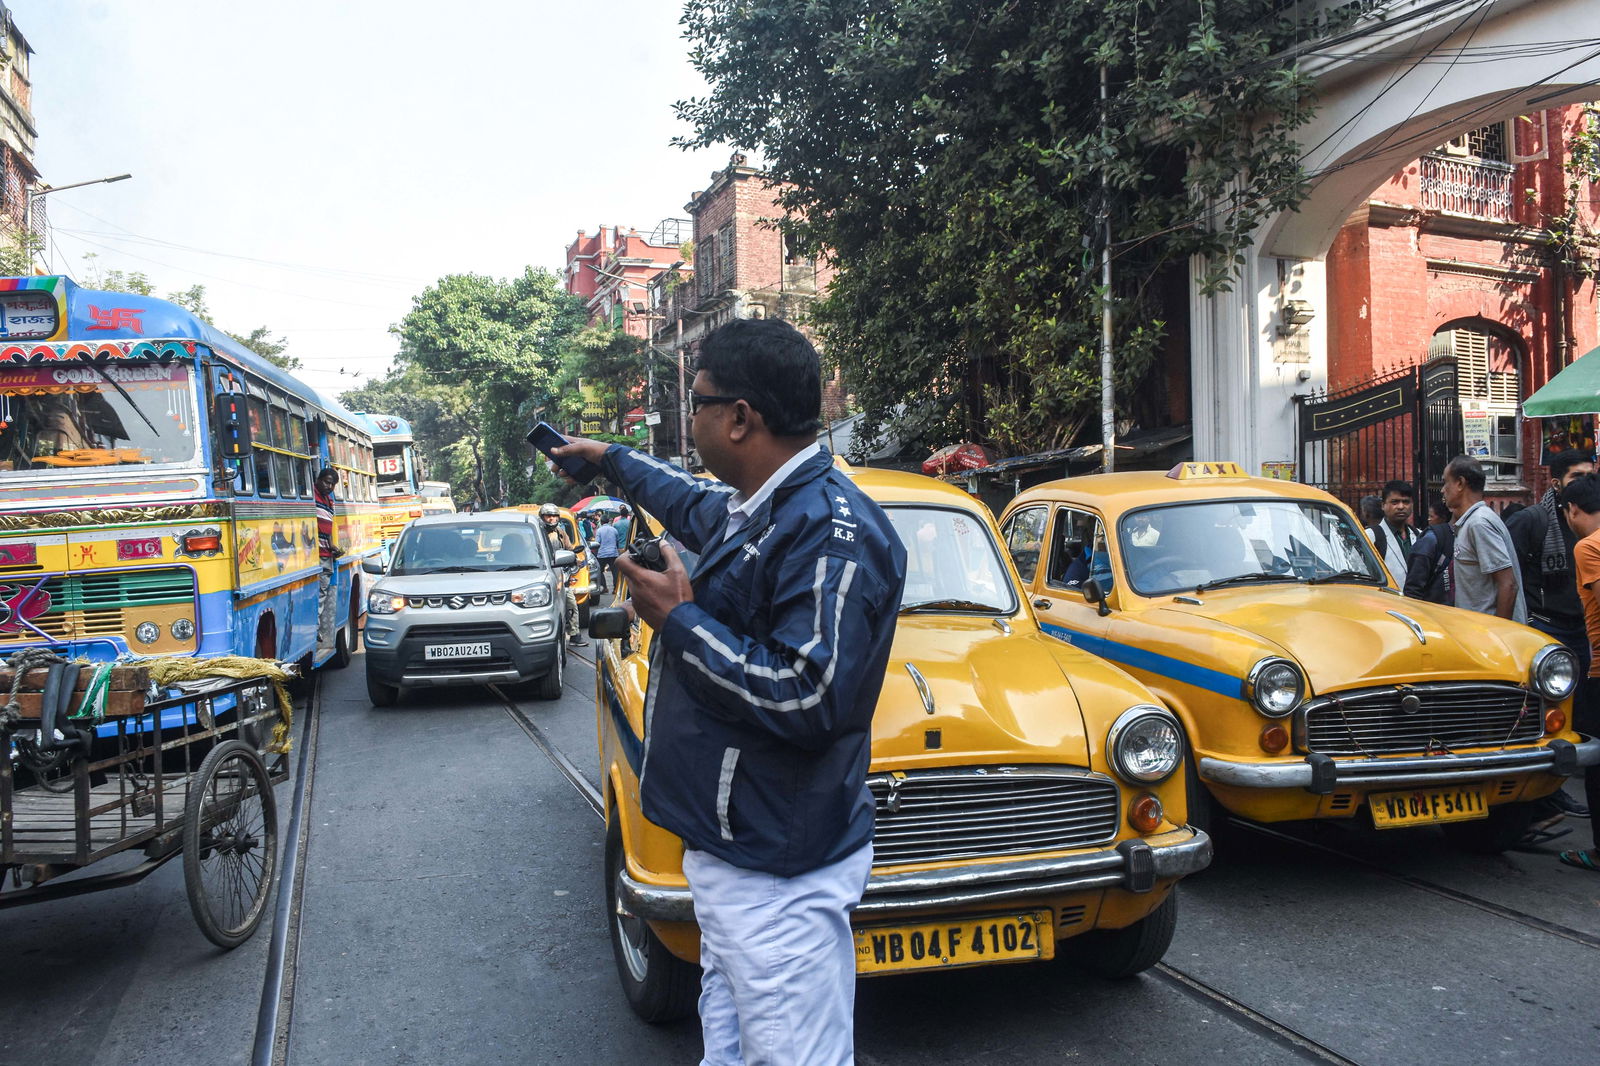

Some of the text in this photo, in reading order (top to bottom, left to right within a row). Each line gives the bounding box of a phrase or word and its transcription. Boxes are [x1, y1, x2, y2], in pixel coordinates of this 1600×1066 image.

[383, 459, 397, 473] 13
[1187, 463, 1238, 475] TAXI
[833, 527, 855, 542] K.P.
[124, 542, 155, 554] 916
[430, 645, 490, 657] WB02AU2415
